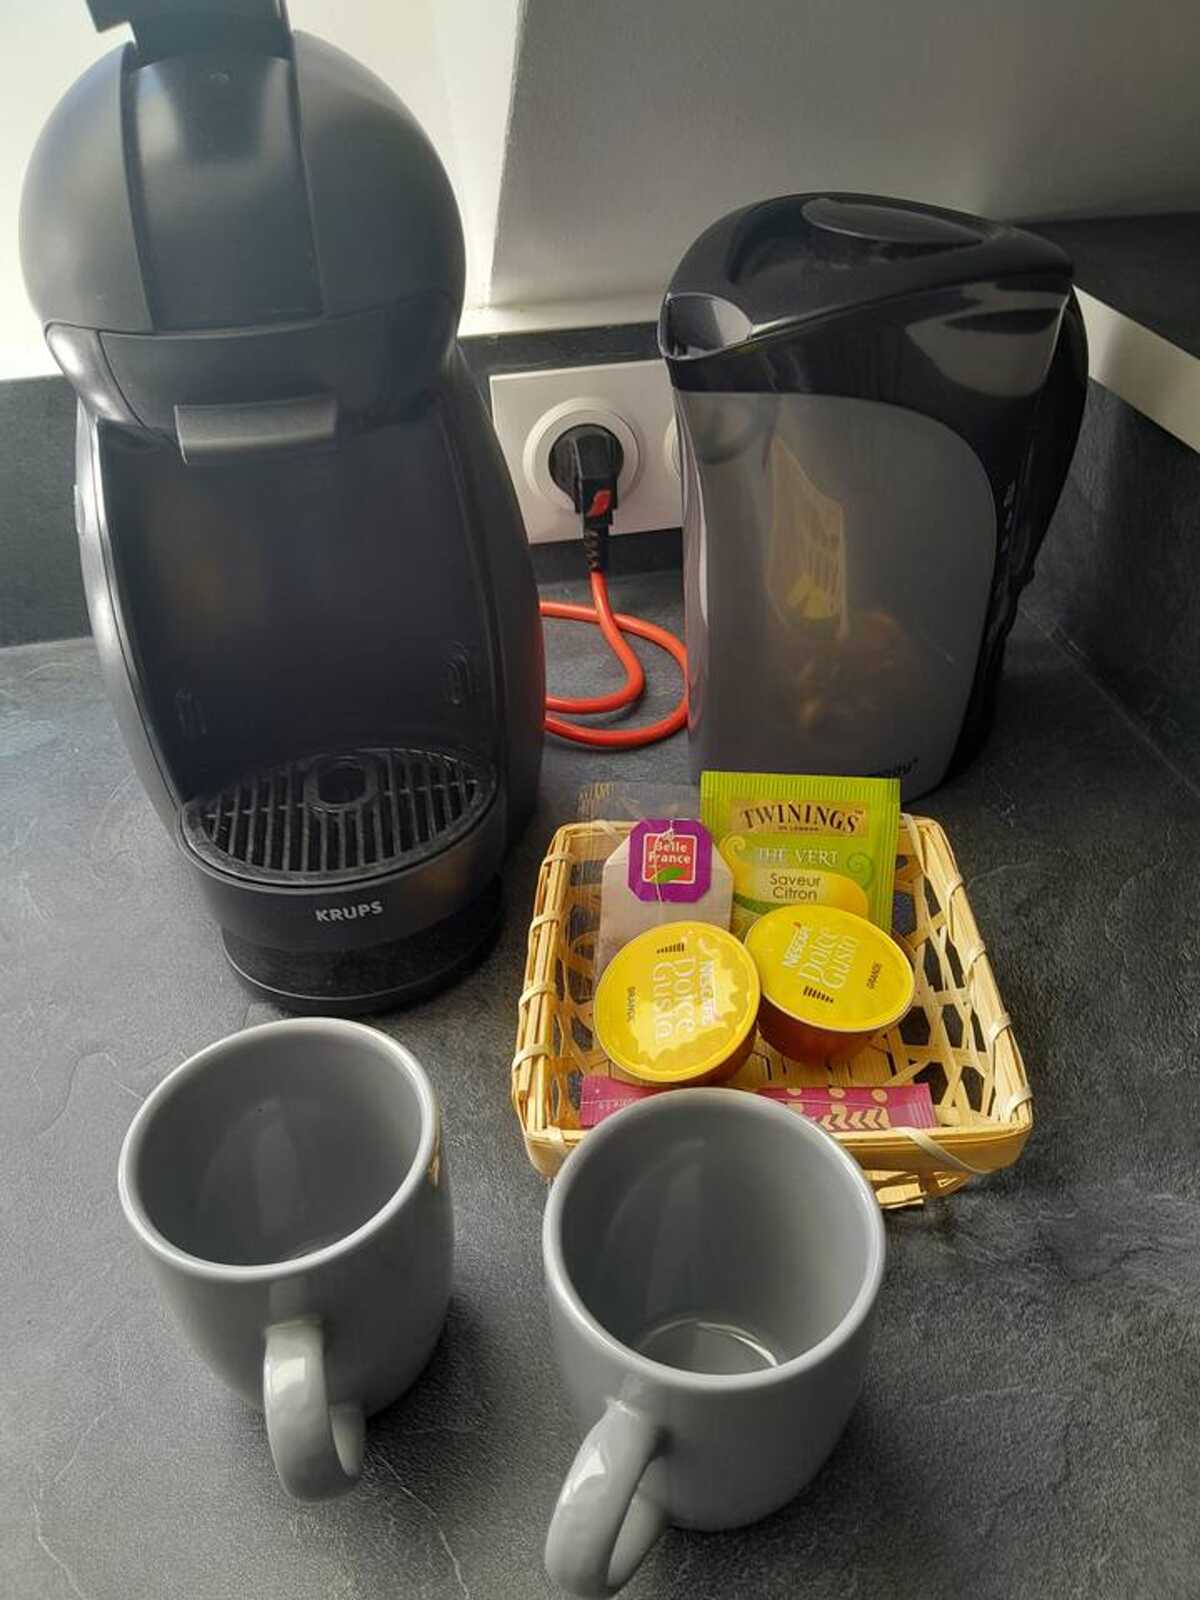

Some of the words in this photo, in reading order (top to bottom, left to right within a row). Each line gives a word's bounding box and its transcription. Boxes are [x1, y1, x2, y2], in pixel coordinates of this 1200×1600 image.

[741, 803, 860, 834] TWININGS
[654, 840, 688, 853] Belle
[648, 853, 691, 865] France
[795, 848, 839, 867] VERT
[770, 872, 821, 887] Saveur
[772, 886, 818, 900] Citron
[315, 901, 383, 921] KRUPS
